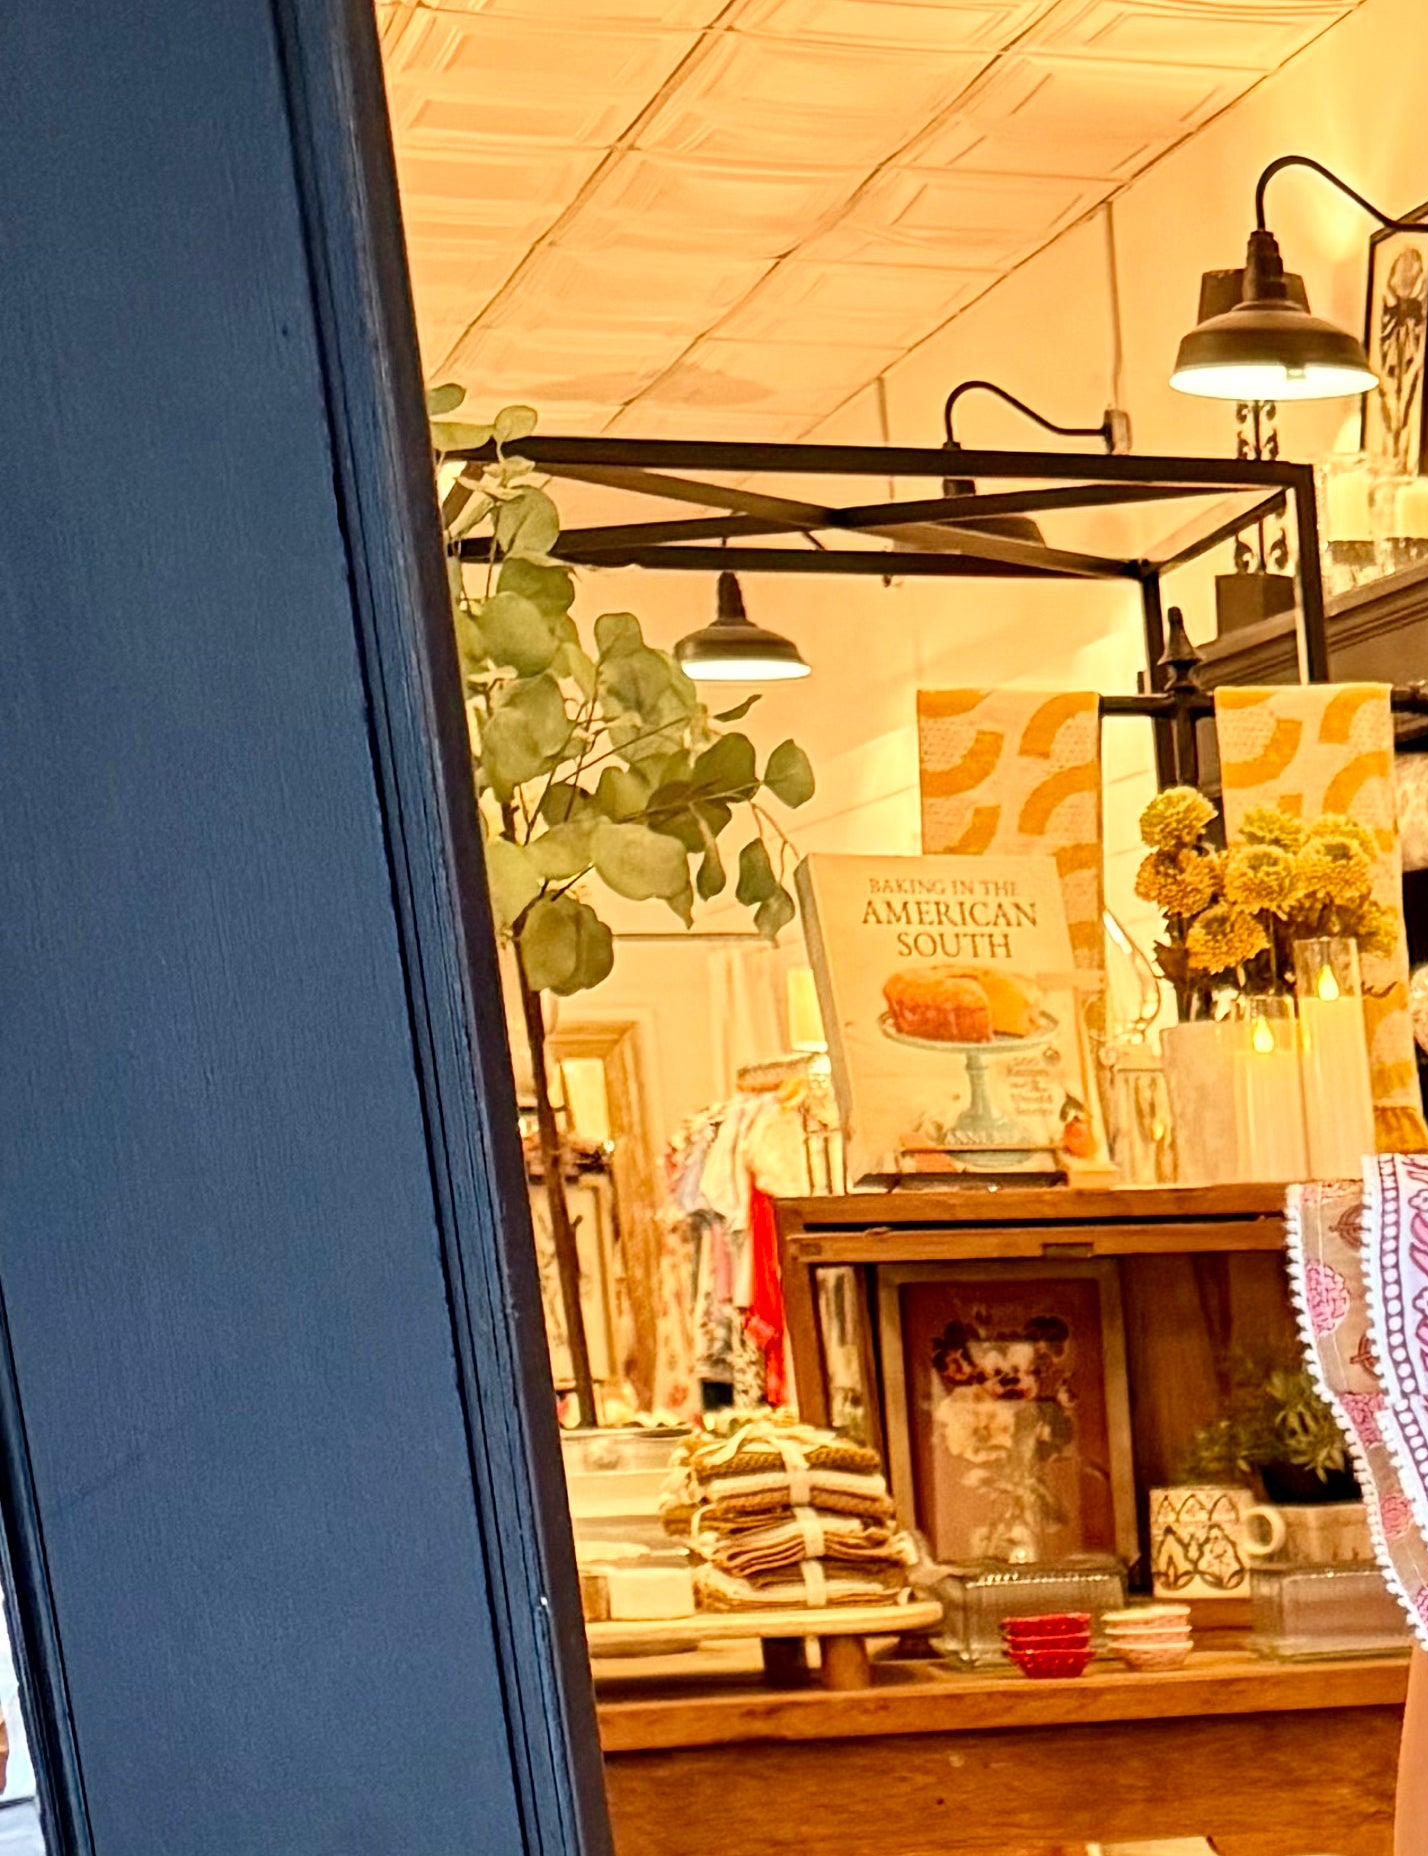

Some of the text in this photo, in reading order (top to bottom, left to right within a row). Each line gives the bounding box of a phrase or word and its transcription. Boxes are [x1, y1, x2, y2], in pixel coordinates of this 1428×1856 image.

[869, 877, 1018, 897] BAKING IN THE
[861, 900, 1038, 928] AMERICAN
[896, 931, 1013, 959] SOUTH
